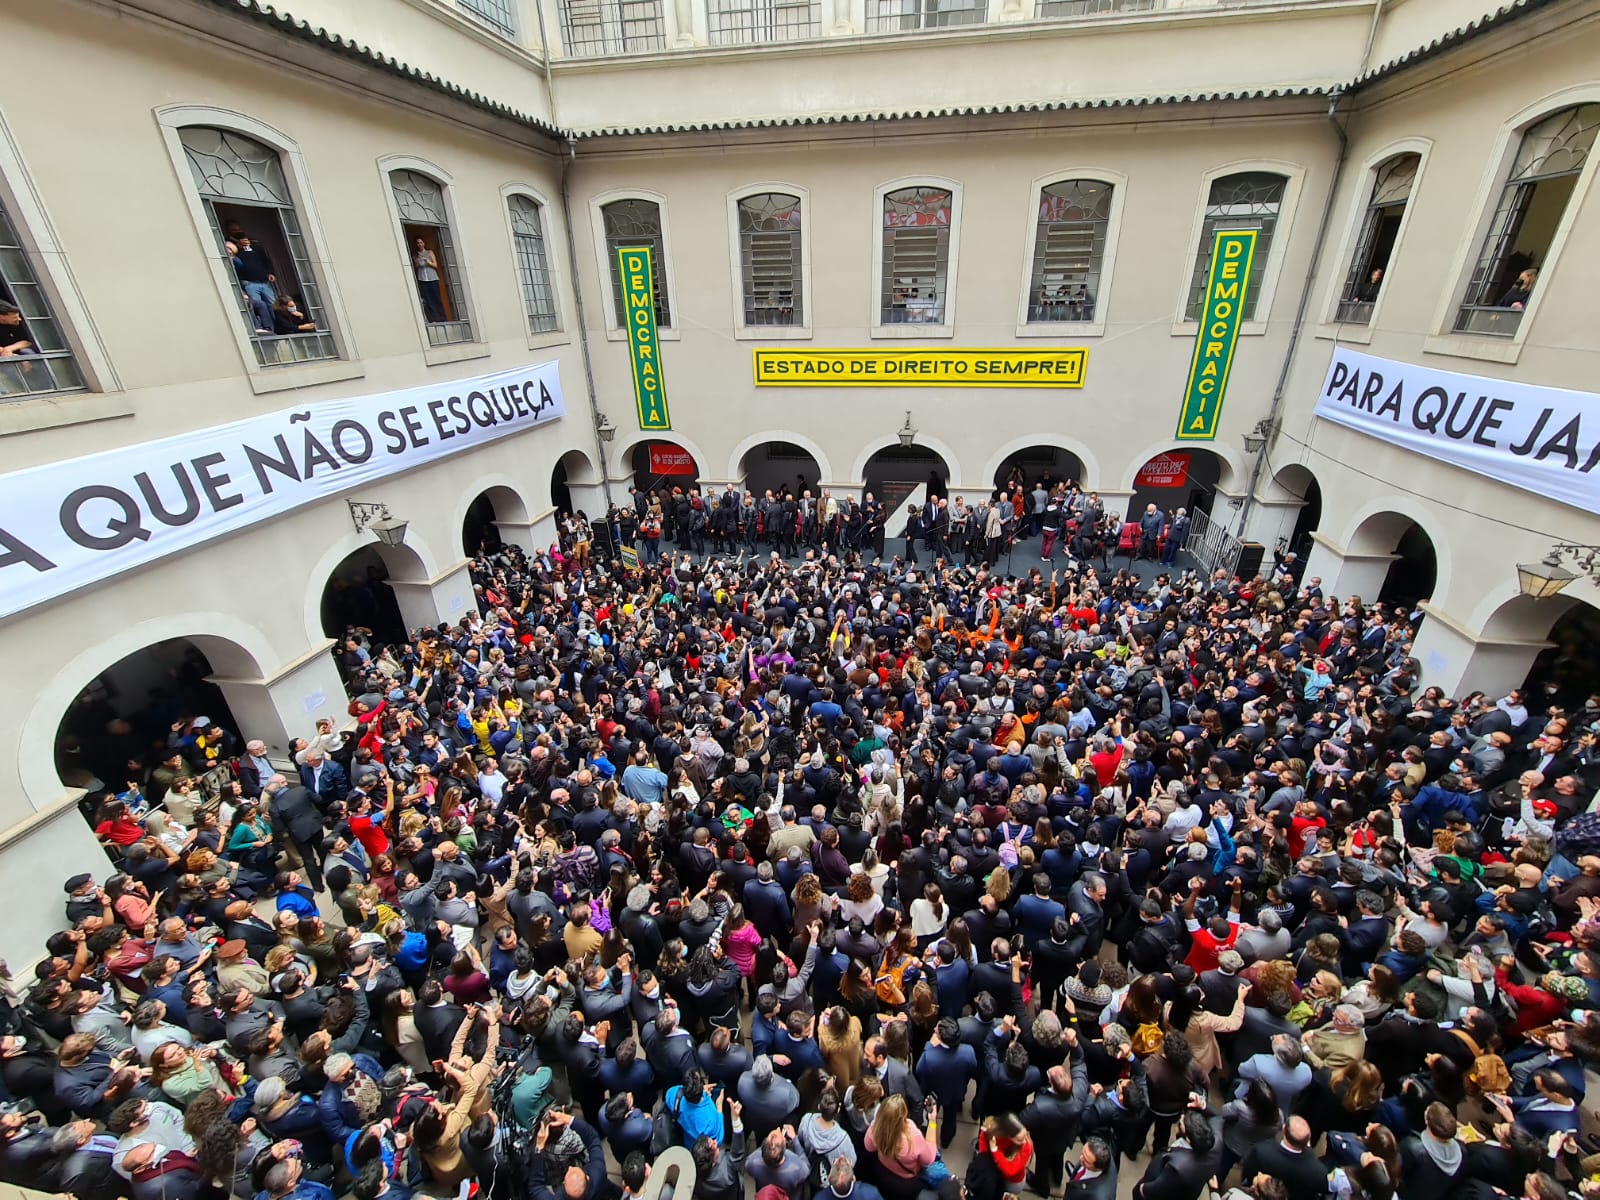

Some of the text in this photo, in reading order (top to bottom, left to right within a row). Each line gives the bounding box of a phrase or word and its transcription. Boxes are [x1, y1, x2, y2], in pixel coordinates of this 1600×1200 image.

[627, 255, 660, 422] DEMOCRACIA
[763, 360, 1076, 374] ESTADO DE DIREITO SEMPRE!
[1190, 240, 1243, 431] DEMOCRACIA
[1326, 362, 1403, 422] PARA
[1412, 386, 1515, 448] QUE
[59, 452, 243, 551] QUE
[243, 411, 373, 494] NÃO
[378, 406, 429, 455] SE
[428, 379, 554, 441] ESQUEÇA
